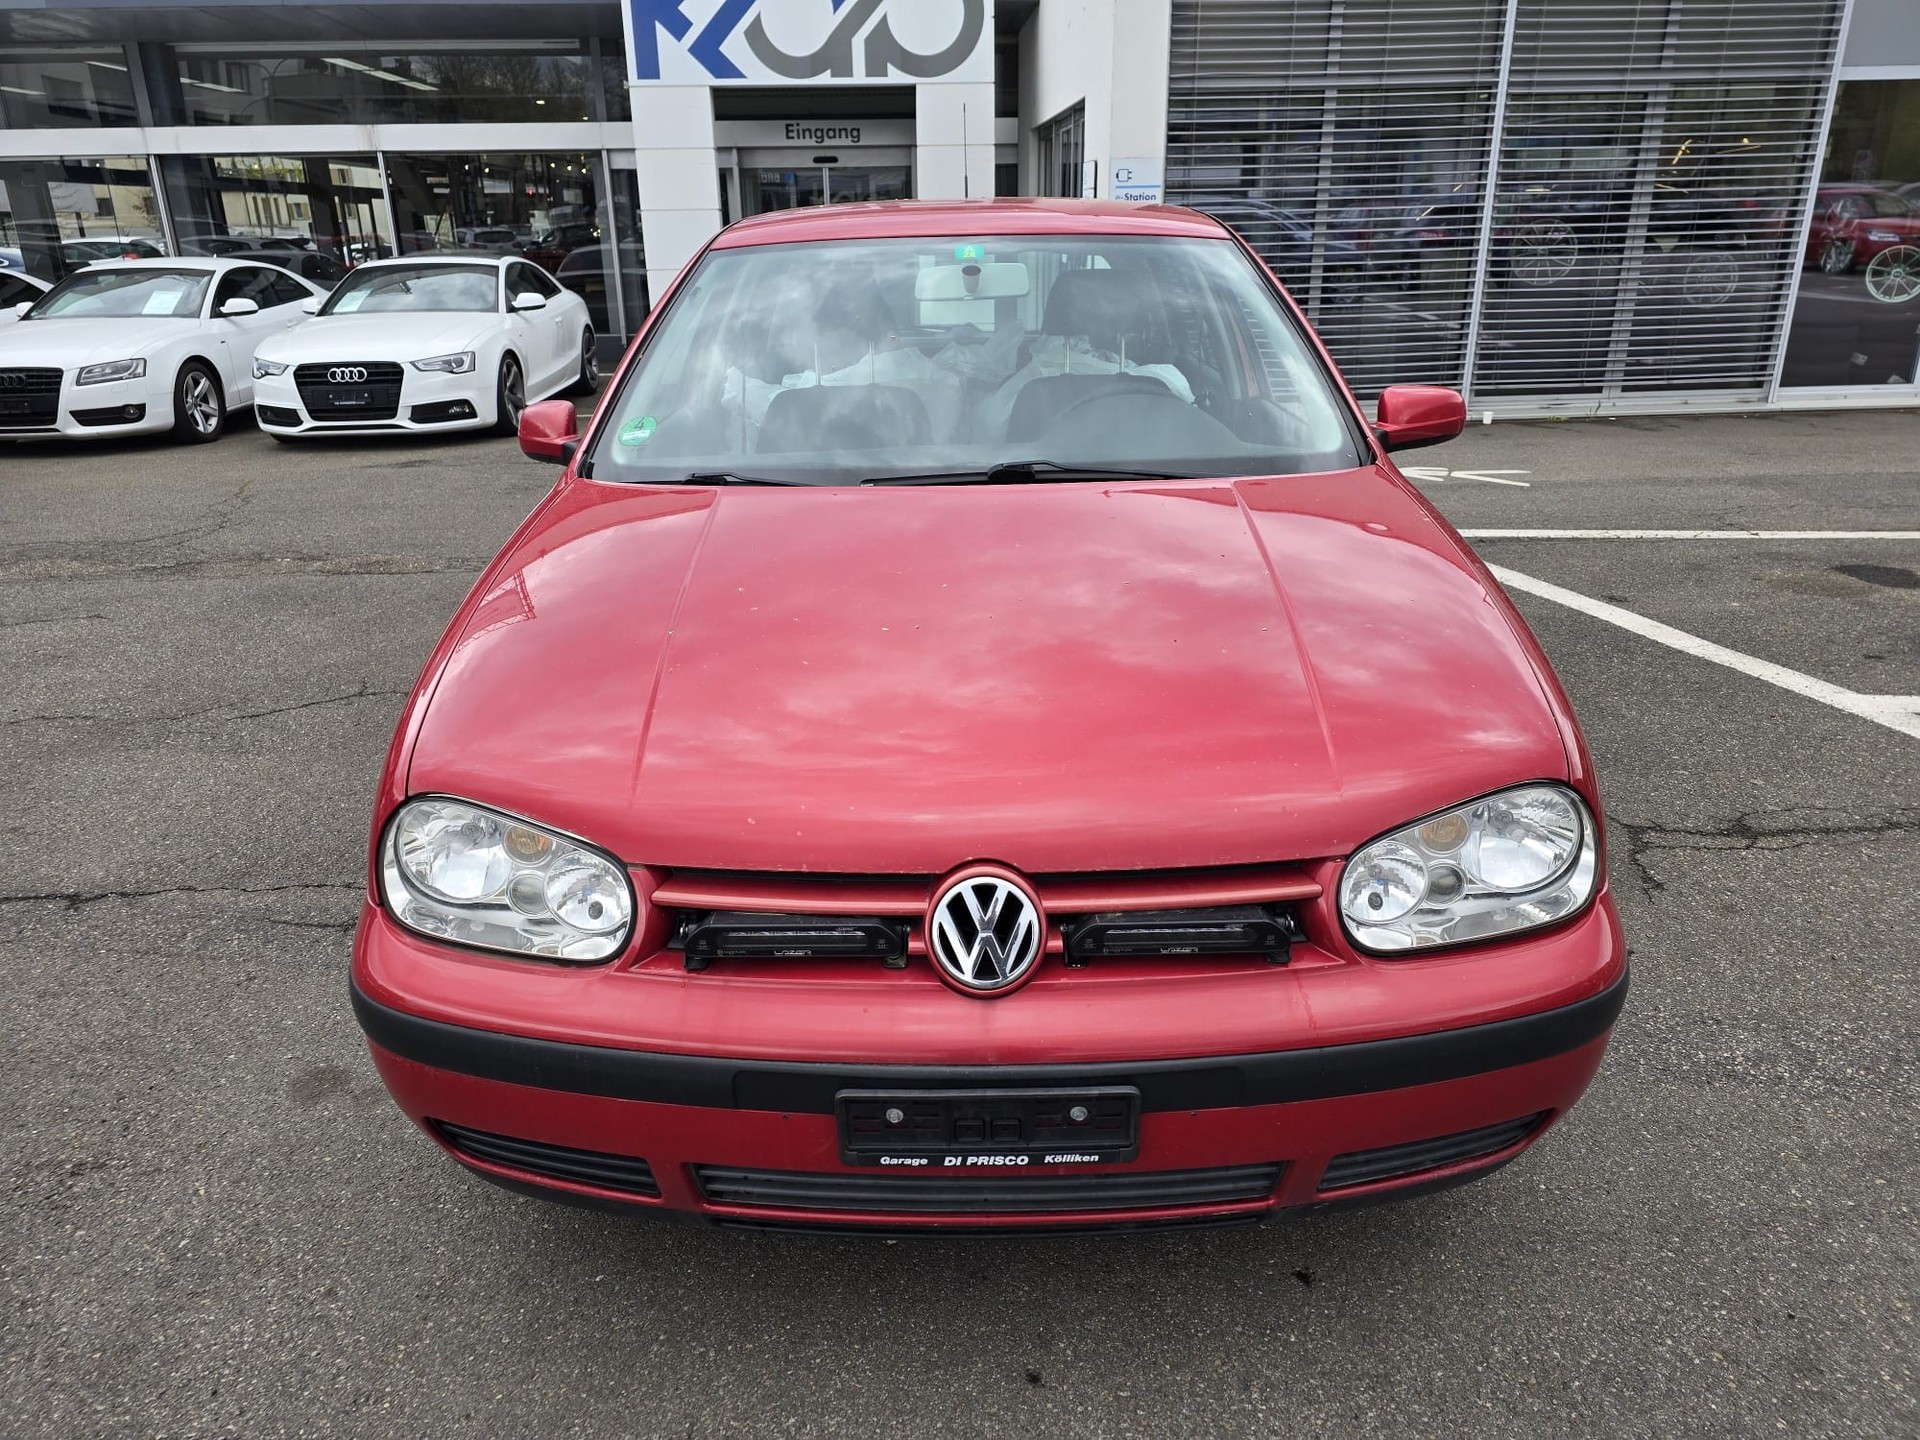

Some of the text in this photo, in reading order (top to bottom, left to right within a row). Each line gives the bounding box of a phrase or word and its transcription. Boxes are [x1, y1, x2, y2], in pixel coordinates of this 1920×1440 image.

[785, 122, 861, 144] Eingang
[633, 416, 645, 430] 4
[880, 1154, 1100, 1166] Garage DI PRISCO Kölliken
